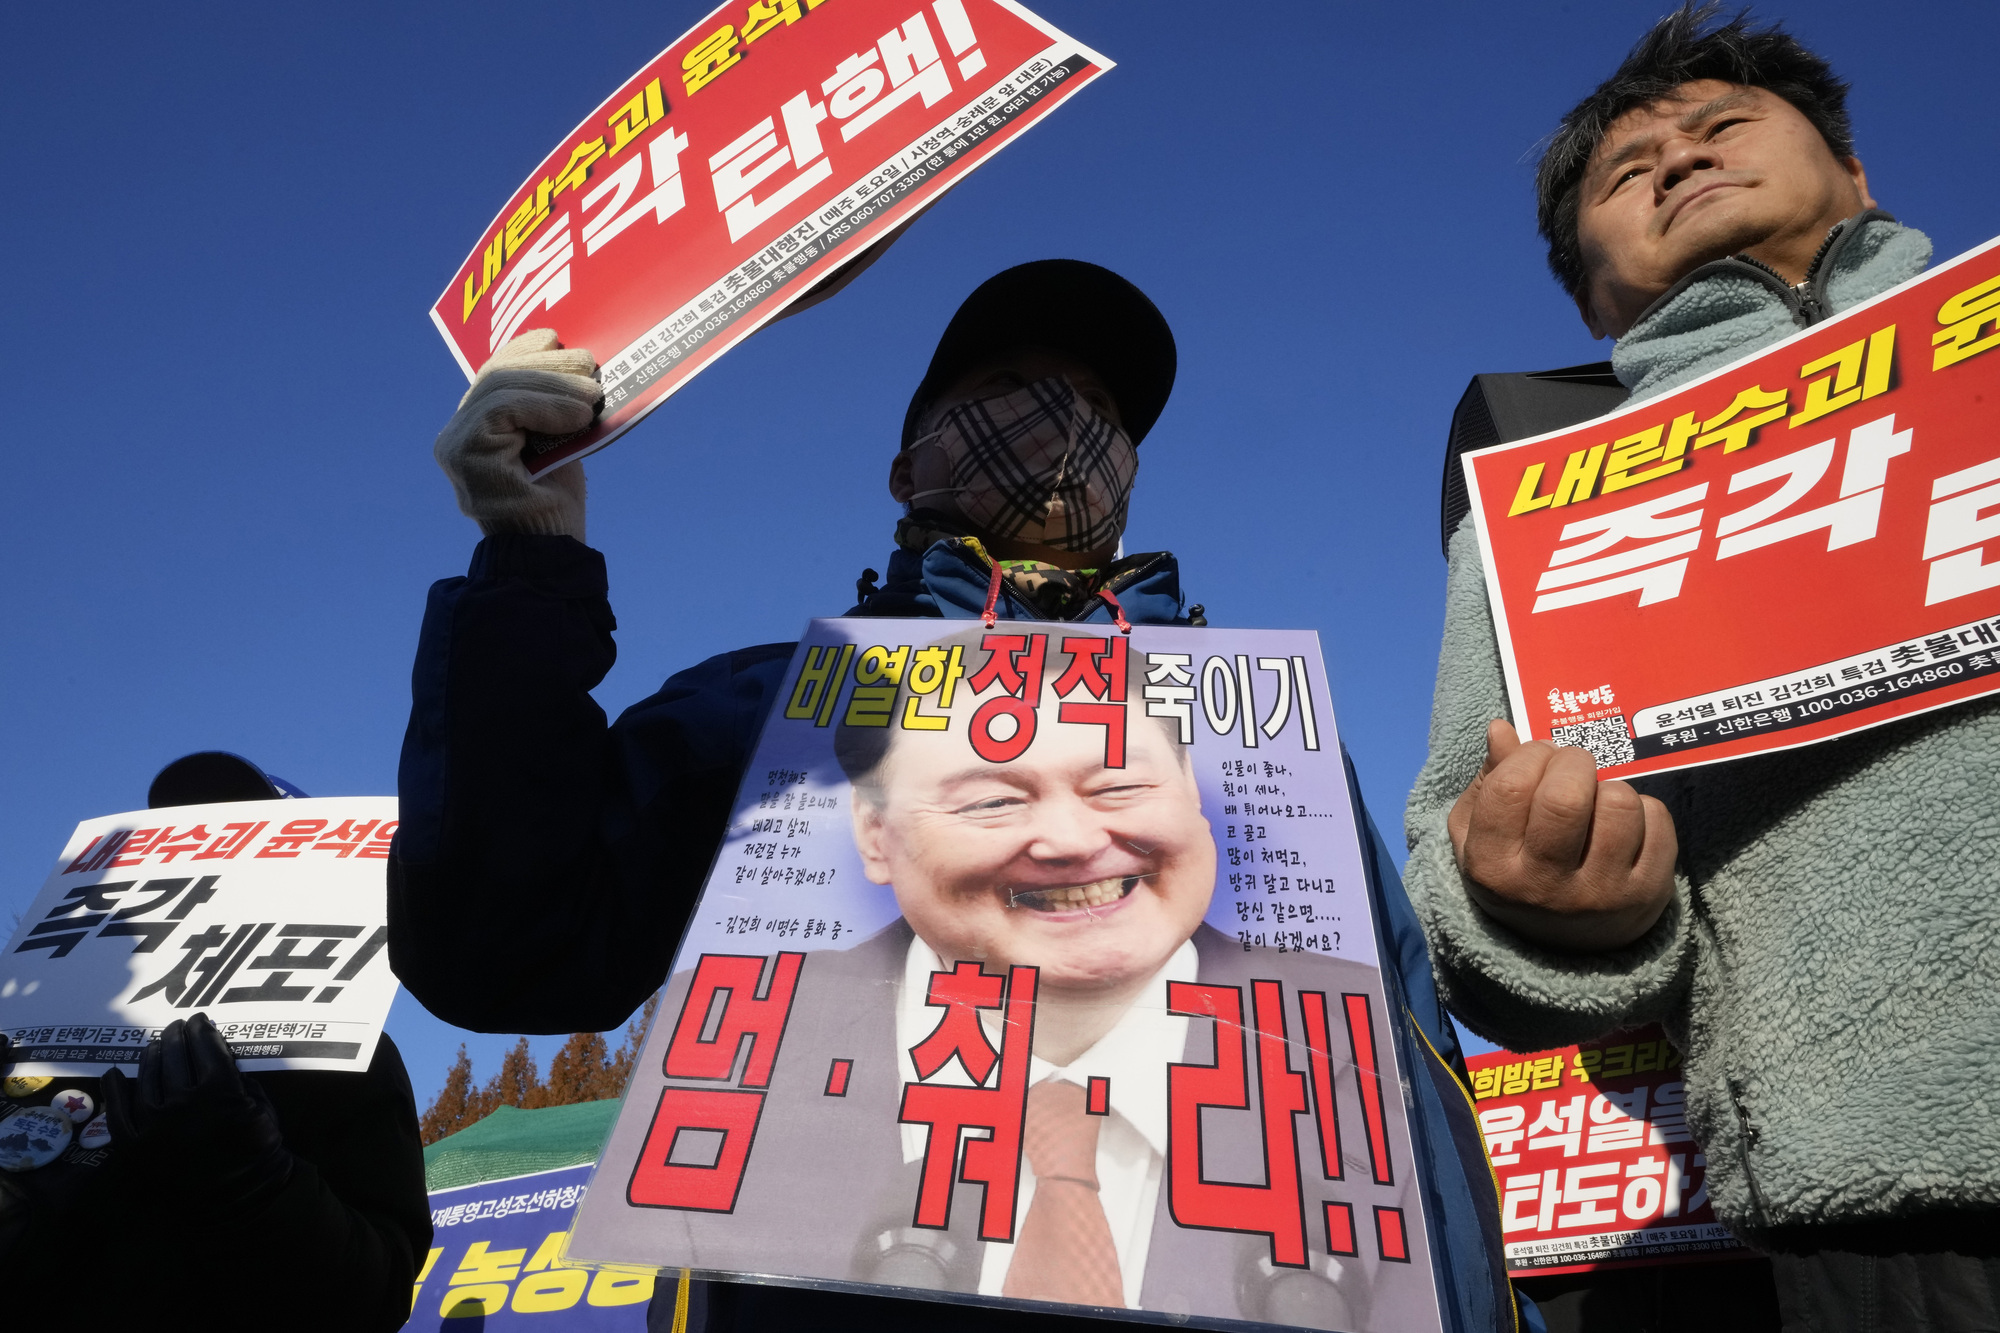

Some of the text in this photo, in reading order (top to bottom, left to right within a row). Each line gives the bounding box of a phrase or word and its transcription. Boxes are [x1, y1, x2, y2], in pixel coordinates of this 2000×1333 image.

[463, 0, 826, 325] 내란수괴 윤석
[490, 0, 988, 354] 즉각 탄핵!
[600, 360, 632, 391] 석열
[630, 339, 660, 365] 퇴진
[657, 309, 700, 344] 김건희
[698, 289, 727, 313] 특검
[723, 220, 819, 294] 촛불대행진
[819, 196, 855, 226] (매주
[855, 164, 902, 200] 토요일
[911, 95, 1001, 161] 시청역-숭례문
[998, 82, 1018, 98] 앞
[1015, 58, 1053, 85] 대로)
[604, 386, 628, 409] 후원
[635, 345, 682, 385] 신한은행
[681, 279, 773, 350] 100-036-164860
[771, 244, 818, 283] 촛불행동
[826, 222, 851, 243] ARS
[850, 168, 927, 226] 060-707-3300
[926, 155, 945, 171] (한
[942, 137, 970, 158] 통에
[967, 124, 989, 141] 1만
[987, 113, 1007, 127] 원,
[1003, 96, 1030, 114] 여러
[1026, 84, 1043, 97] 번
[1040, 65, 1070, 87] 가능)
[1507, 323, 1896, 518] 내란수괴
[1531, 413, 1914, 614] 즉각
[1655, 619, 2000, 729] 윤석열 퇴진 김건희 특검 촛불대
[783, 633, 1321, 770] 비열한 정적 죽이기
[1661, 728, 1698, 747] 후원
[1715, 707, 1792, 736] 신한은행
[1797, 662, 1964, 719] 100-036-164860
[1551, 706, 1622, 727] 촛불행동 회원가입
[768, 769, 808, 786] 멍청해도
[1222, 760, 1257, 778] 인물이
[1222, 780, 1286, 797] 힘이 세나,
[783, 792, 796, 811] 잘
[798, 792, 838, 811] 들으니까
[1224, 804, 1238, 816] 배
[752, 817, 811, 838] 데리고 살지,
[1226, 824, 1267, 842] 코 골고
[61, 820, 270, 876] 내란수괴
[743, 842, 802, 860] 저런걸 누가
[1226, 847, 1307, 868] 많이 처먹고,
[735, 865, 836, 886] 같이 살아주겠어요?
[1229, 873, 1336, 895] 방귀 달고 다니고
[14, 874, 222, 959] 즉각
[1236, 901, 1265, 922] 당신
[726, 914, 762, 935] 김건희
[766, 918, 800, 938] 이명수
[803, 918, 827, 939] 통화
[831, 920, 843, 941] 중
[1237, 930, 1341, 953] 같이 살겠어요?
[126, 922, 388, 1008] 체포!
[11, 1027, 55, 1046] 윤석열
[55, 1026, 117, 1044] 탄핵기금
[117, 1028, 147, 1044] 5억
[30, 1049, 67, 1060] 탄핵기금
[67, 1049, 87, 1060] 모금
[95, 1050, 133, 1061] 신한은행
[1571, 1038, 1684, 1083] 우크라
[13, 1117, 62, 1139] 독도 수호
[431, 1184, 588, 1228] 제통영고성조선하청
[1513, 1246, 1534, 1256] 윤석열
[1535, 1243, 1550, 1254] 퇴진
[1551, 1242, 1573, 1252] 김건희
[1574, 1240, 1588, 1250] 특검
[1589, 1231, 1643, 1249] 촛불대행진
[1646, 1232, 1669, 1244] (매주
[1670, 1229, 1698, 1240] 토요일
[1514, 1258, 1529, 1267] 후원
[1533, 1255, 1559, 1266] 신한은행
[1559, 1250, 1612, 1263] 100-036-164860
[1645, 1245, 1661, 1255] ARS
[1661, 1242, 1710, 1253] 060-707-3300
